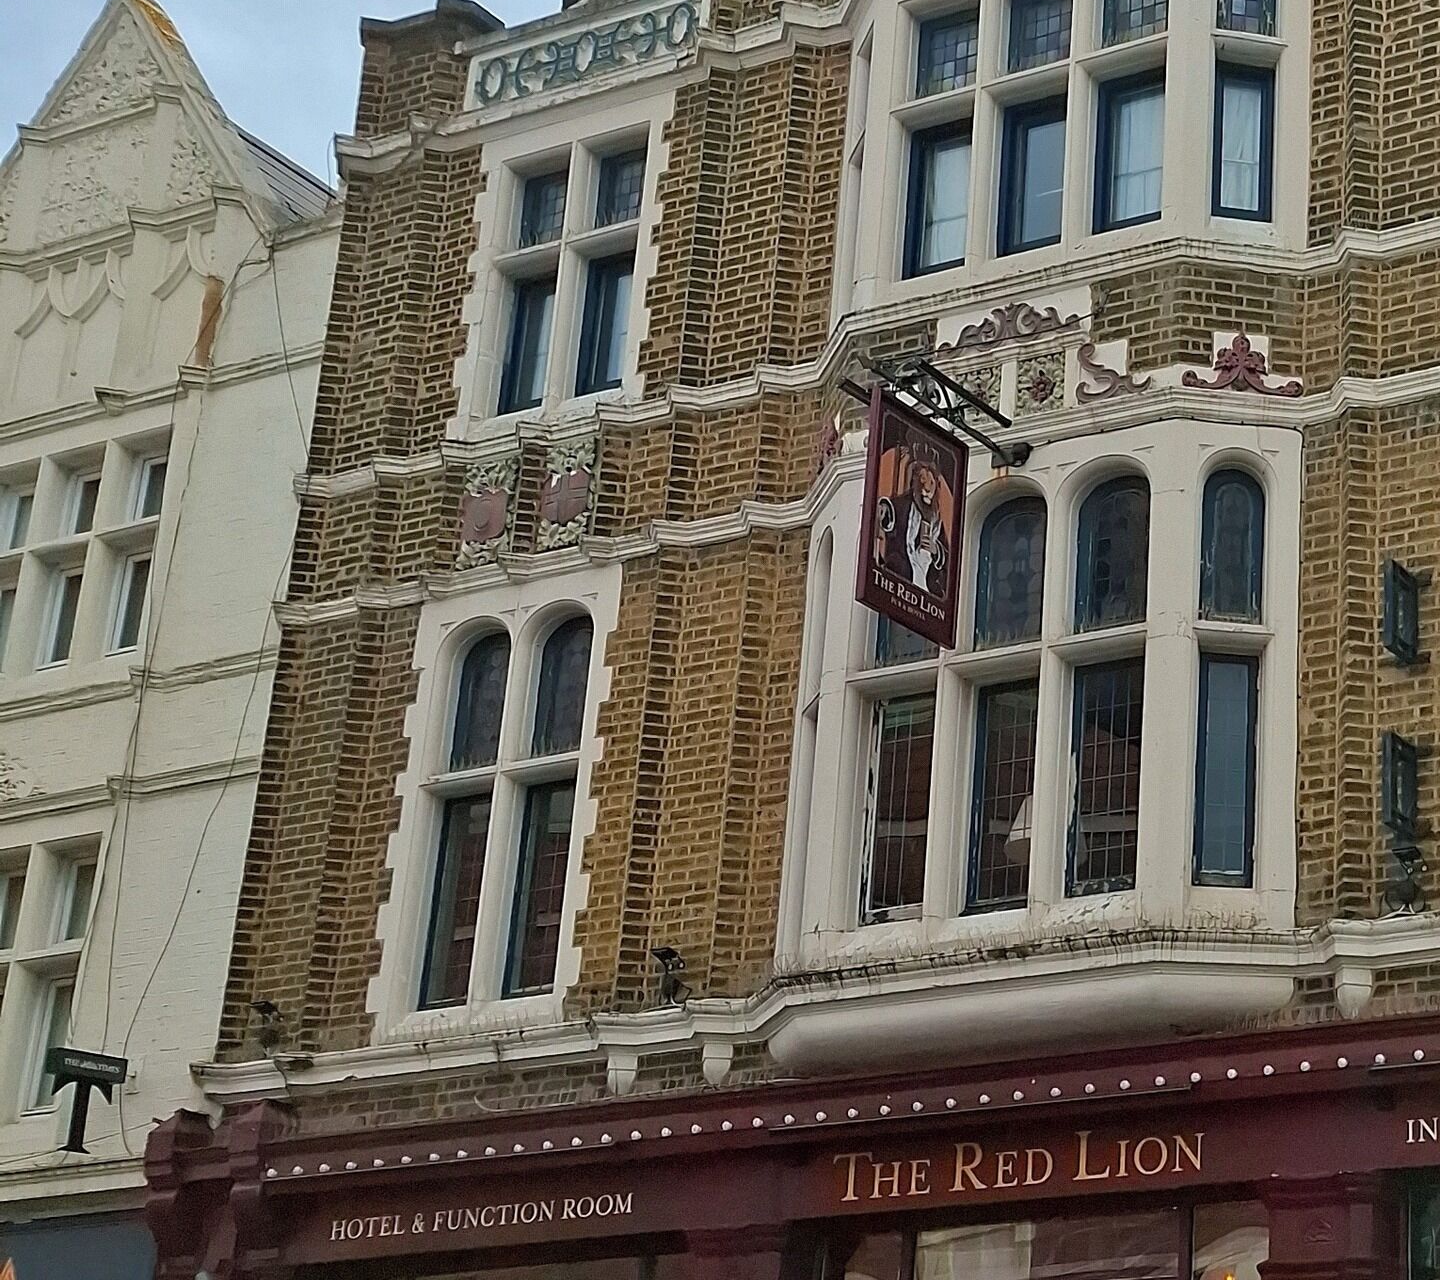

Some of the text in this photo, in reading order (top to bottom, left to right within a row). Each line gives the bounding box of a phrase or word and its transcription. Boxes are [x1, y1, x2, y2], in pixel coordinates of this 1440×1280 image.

[872, 569, 945, 620] THE RED LION
[833, 1130, 1205, 1201] THE RED LION
[329, 1192, 634, 1241] HOTEL & FUNCTION ROOM
